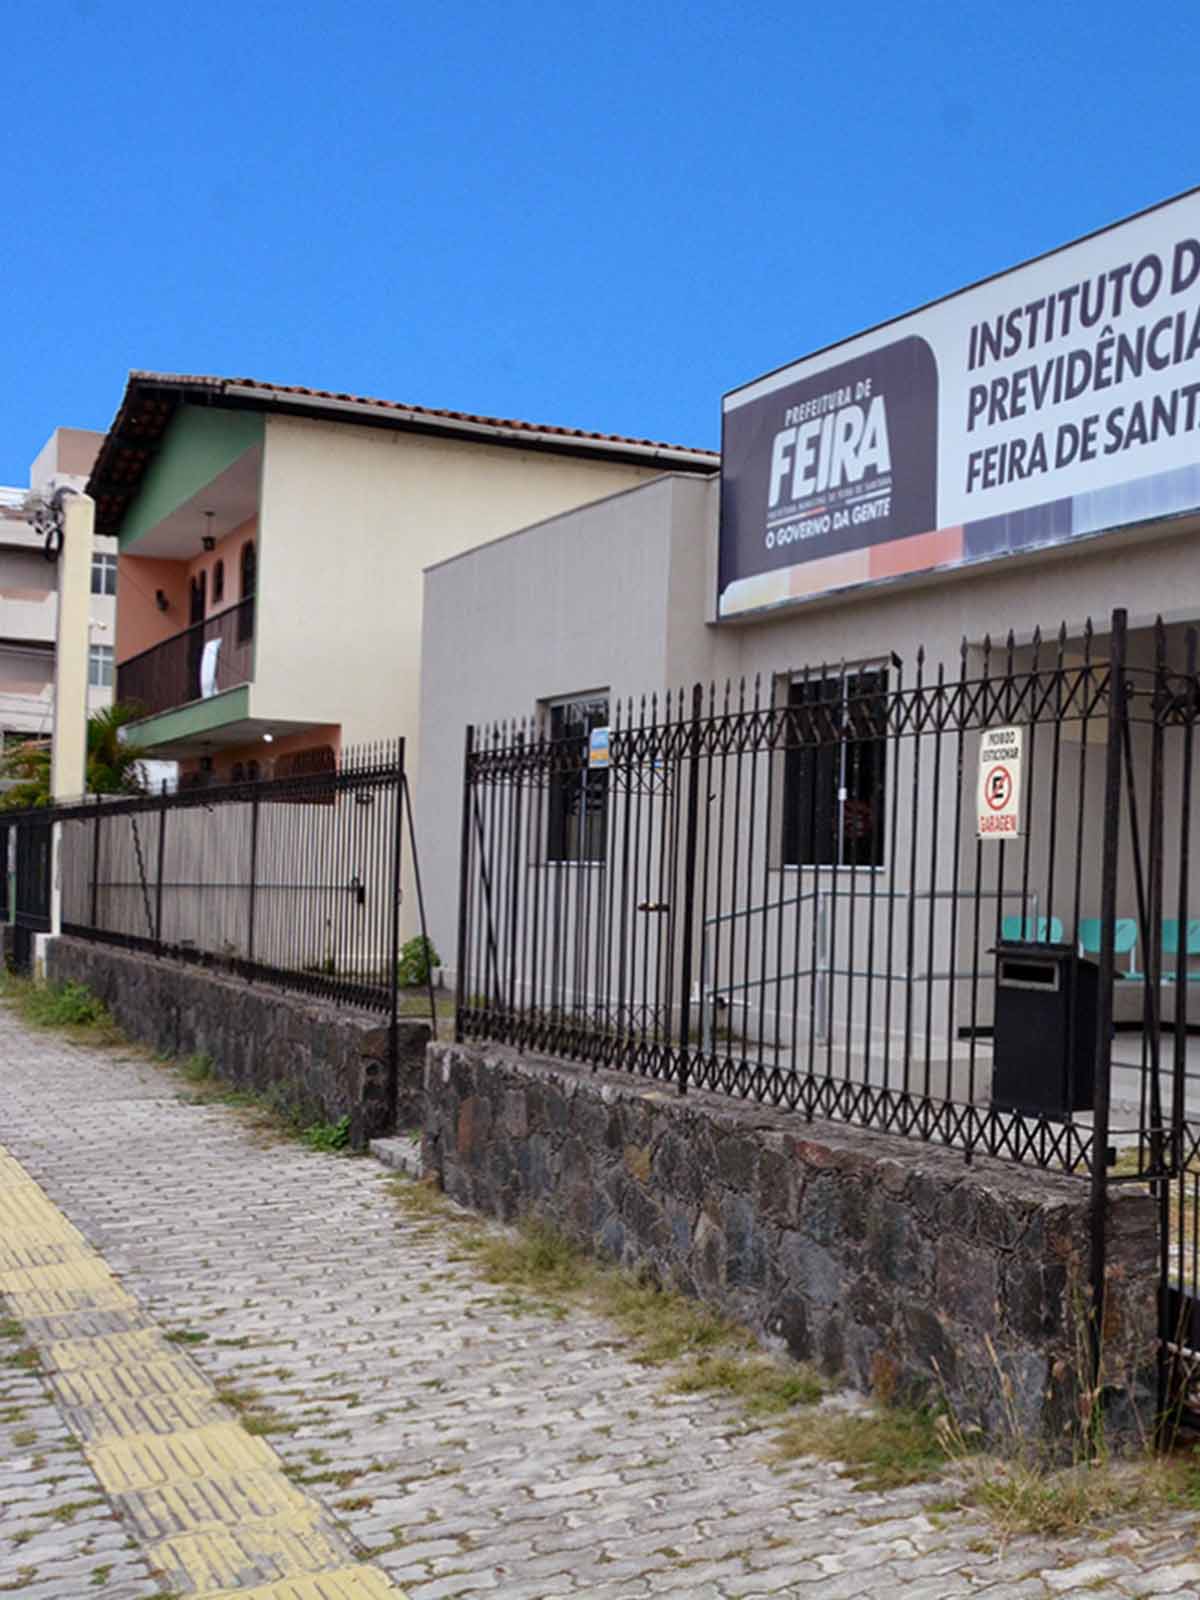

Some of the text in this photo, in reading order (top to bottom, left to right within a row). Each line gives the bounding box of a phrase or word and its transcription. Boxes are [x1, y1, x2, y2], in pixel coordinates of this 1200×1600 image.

[967, 253, 1163, 372] INSTITUTO
[786, 378, 872, 425] PREFEITURA DE
[768, 395, 891, 508] FEIRA
[965, 432, 1049, 494] FEIRA
[1054, 414, 1100, 470] DE
[765, 531, 775, 549] O
[777, 515, 831, 544] GOVERNO
[832, 509, 850, 531] DA
[852, 497, 891, 524] GENTE
